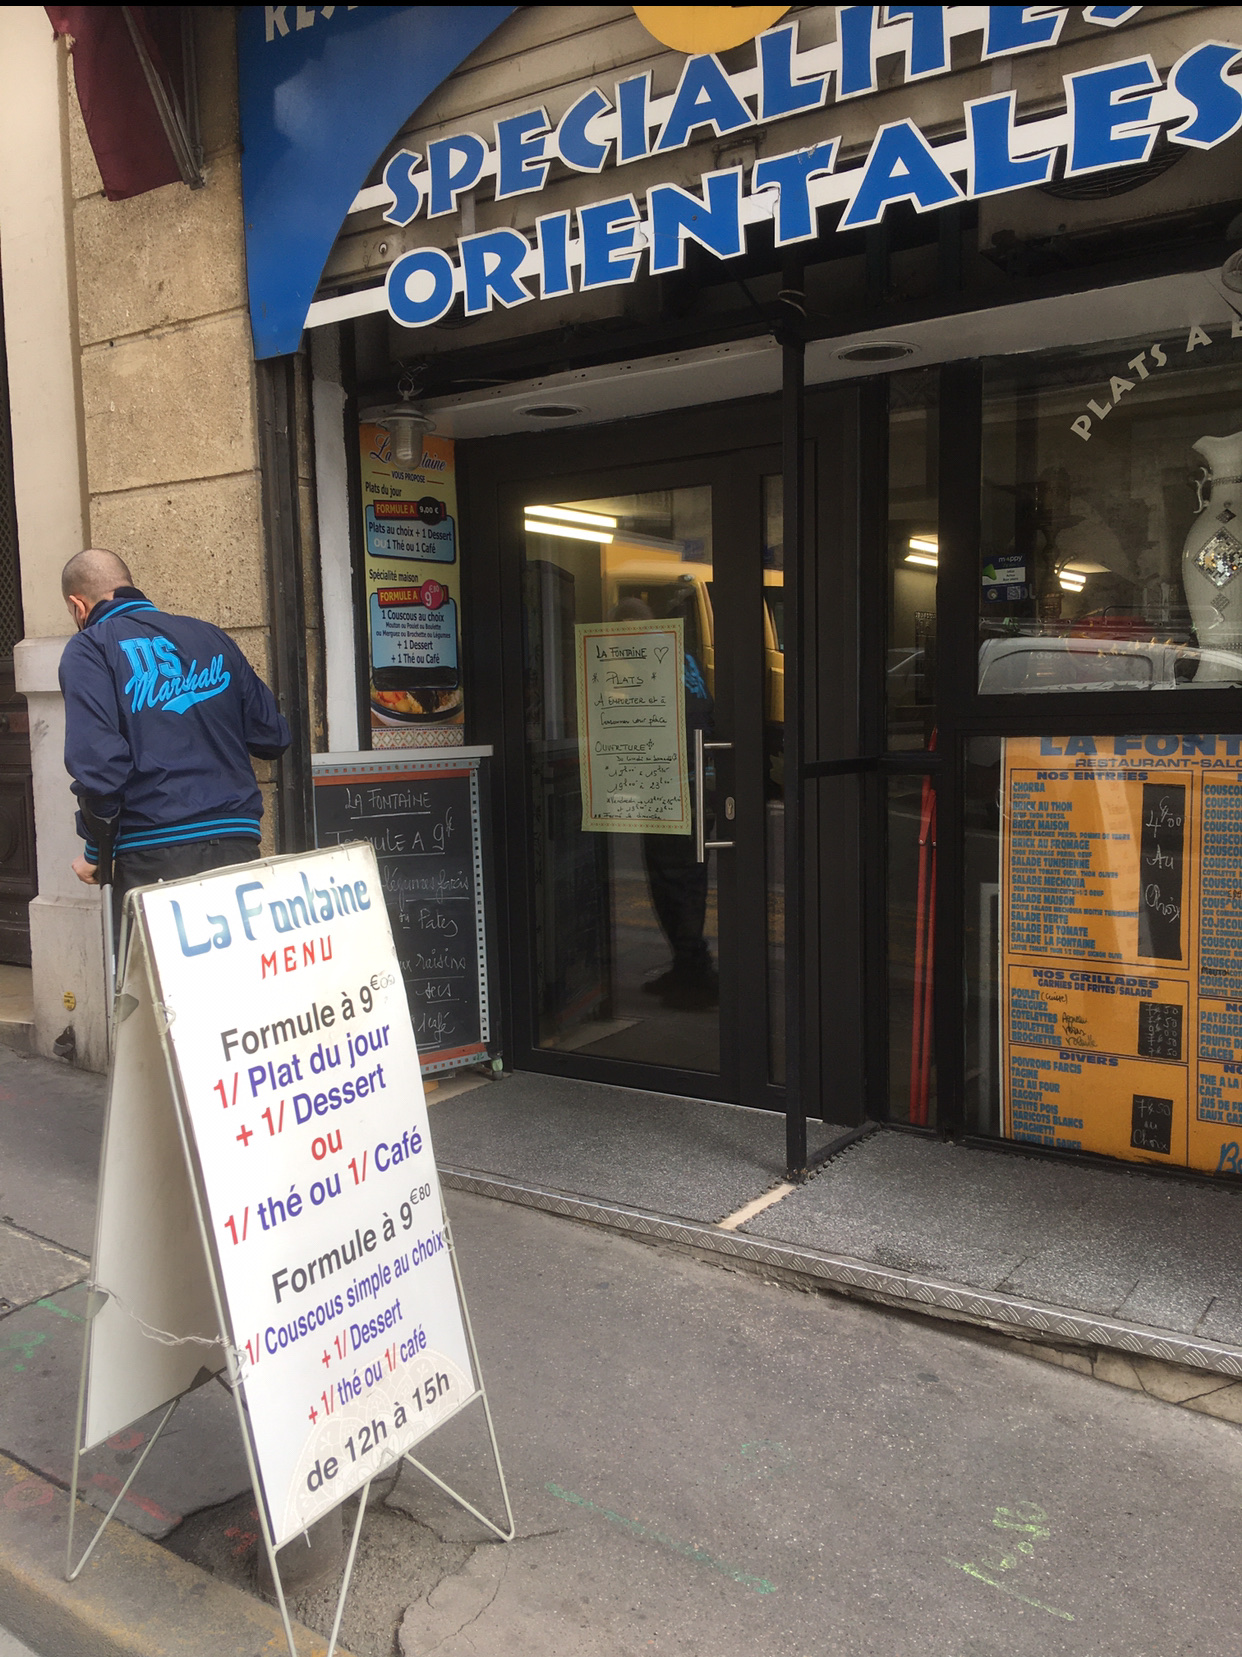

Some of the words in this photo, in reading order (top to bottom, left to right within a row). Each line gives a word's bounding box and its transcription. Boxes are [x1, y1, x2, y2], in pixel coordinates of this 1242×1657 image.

[385, 38, 1242, 328] ORIENTALES
[1070, 343, 1167, 441] PLATS
[1185, 324, 1213, 353] A
[370, 434, 392, 464] La
[392, 471, 404, 480] VOUS
[405, 473, 425, 483] PROPOSE
[365, 482, 380, 493] Plats
[381, 484, 388, 494] du
[390, 486, 402, 498] jour
[376, 504, 408, 514] FORMULE
[410, 505, 415, 514] A
[368, 521, 385, 533] Plats
[386, 525, 395, 535] au
[397, 525, 414, 537] choix
[428, 529, 452, 541] Dessert
[393, 539, 404, 550] Thé
[406, 543, 414, 551] ou
[421, 542, 436, 554] Café
[369, 568, 397, 582] Spécialité
[398, 573, 418, 583] maison
[380, 592, 412, 601] FORMULE
[413, 592, 419, 600] A
[388, 610, 417, 622] Couscous
[418, 612, 426, 621] au
[428, 611, 444, 622] choix
[409, 640, 433, 650] Dessert
[404, 652, 415, 664] Thé
[416, 656, 424, 664] ou
[425, 653, 440, 664] Café
[125, 653, 223, 713] Marshall
[606, 671, 644, 685] PLATS
[1040, 735, 1097, 756] LA
[1037, 772, 1069, 780] NOS
[1074, 772, 1148, 781] ENTREES
[1013, 782, 1046, 792] CHORBA
[1013, 801, 1036, 811] BRICK
[1038, 802, 1049, 811] AU
[1051, 802, 1073, 812] THON
[1012, 820, 1035, 829] BRICK
[1038, 821, 1069, 830] MAISON
[411, 831, 425, 851] A
[1012, 838, 1035, 848] BRICK
[1038, 839, 1048, 848] AU
[1050, 839, 1090, 850] FROMAGE
[1012, 856, 1041, 867] SALADE
[1044, 858, 1090, 869] TUNISIENNE
[1011, 874, 1042, 885] SALADE
[1044, 876, 1086, 888] MECHOUIA
[1011, 893, 1042, 904] SALADE
[1044, 895, 1075, 906] MAISON
[170, 900, 232, 958] La
[235, 871, 371, 941] Fontaine
[1011, 911, 1041, 922] SALADE
[1044, 913, 1069, 924] VERTE
[1011, 922, 1041, 933] SALADE
[1044, 924, 1054, 934] DE
[1056, 925, 1088, 937] TOMATE
[1011, 932, 1041, 944] SALADE
[1044, 935, 1054, 945] LA
[1056, 936, 1096, 949] FONTAINE
[260, 935, 333, 980] MENU
[1033, 970, 1065, 979] NOS
[1069, 973, 1159, 989] GRILLADES
[1038, 979, 1072, 990] GARNIES
[1074, 982, 1085, 991] DE
[1011, 988, 1040, 1000] POULET
[1011, 999, 1048, 1011] MERGUEZ
[1011, 1009, 1058, 1023] COTELETTES
[220, 1002, 336, 1062] Formule
[341, 992, 356, 1021] à
[1011, 1020, 1055, 1034] BOULETTES
[1011, 1030, 1063, 1046] BROCHETTES
[1200, 1034, 1232, 1049] FRUITS
[1060, 1051, 1119, 1067] DIVERS
[1200, 1045, 1234, 1060] GLACES
[213, 1072, 239, 1109] 1/
[247, 1053, 303, 1098] Plat
[309, 1044, 341, 1074] du
[346, 1024, 390, 1068] jour
[1012, 1056, 1051, 1070] POIVRONS
[1053, 1061, 1082, 1074] FARCIS
[1011, 1067, 1038, 1079] TAGINE
[1012, 1078, 1024, 1088] RIZ
[1027, 1080, 1037, 1090] AU
[1039, 1081, 1060, 1093] FOUR
[1200, 1074, 1216, 1086] THE
[1219, 1076, 1226, 1087] A
[1228, 1077, 1239, 1088] LA
[1012, 1088, 1042, 1101] RAGOUT
[1200, 1085, 1222, 1098] CAFE
[261, 1100, 285, 1136] 1/
[292, 1063, 386, 1125] Dessert
[1012, 1099, 1038, 1111] PETITS
[1040, 1103, 1058, 1115] POIS
[1200, 1097, 1215, 1109] JUS
[1218, 1100, 1230, 1111] DE
[1013, 1110, 1050, 1124] HARICOTS
[1052, 1115, 1084, 1129] BLANCS
[1200, 1108, 1223, 1122] EAUX
[1013, 1120, 1055, 1135] SPAGHETTI
[311, 1128, 343, 1161] ou
[224, 1206, 248, 1245] 1/
[257, 1184, 303, 1231] thé
[309, 1173, 342, 1206] ou
[348, 1150, 367, 1185] 1/
[374, 1125, 423, 1172] Café
[271, 1228, 377, 1304] Formule
[382, 1212, 396, 1242] à
[246, 1333, 259, 1365] 1/
[264, 1294, 344, 1355] Couscous
[346, 1263, 391, 1308] simple
[394, 1254, 410, 1279] au
[411, 1230, 444, 1267] choix
[334, 1329, 346, 1360] 1/
[350, 1298, 403, 1350] Dessert
[321, 1384, 334, 1416] 1/
[337, 1369, 362, 1406] thé
[364, 1361, 382, 1389] ou
[384, 1343, 396, 1372] 1/
[400, 1324, 427, 1363] café
[307, 1455, 338, 1492] de
[345, 1416, 387, 1463] 12h
[394, 1402, 407, 1429] à
[412, 1372, 450, 1412] 15h
